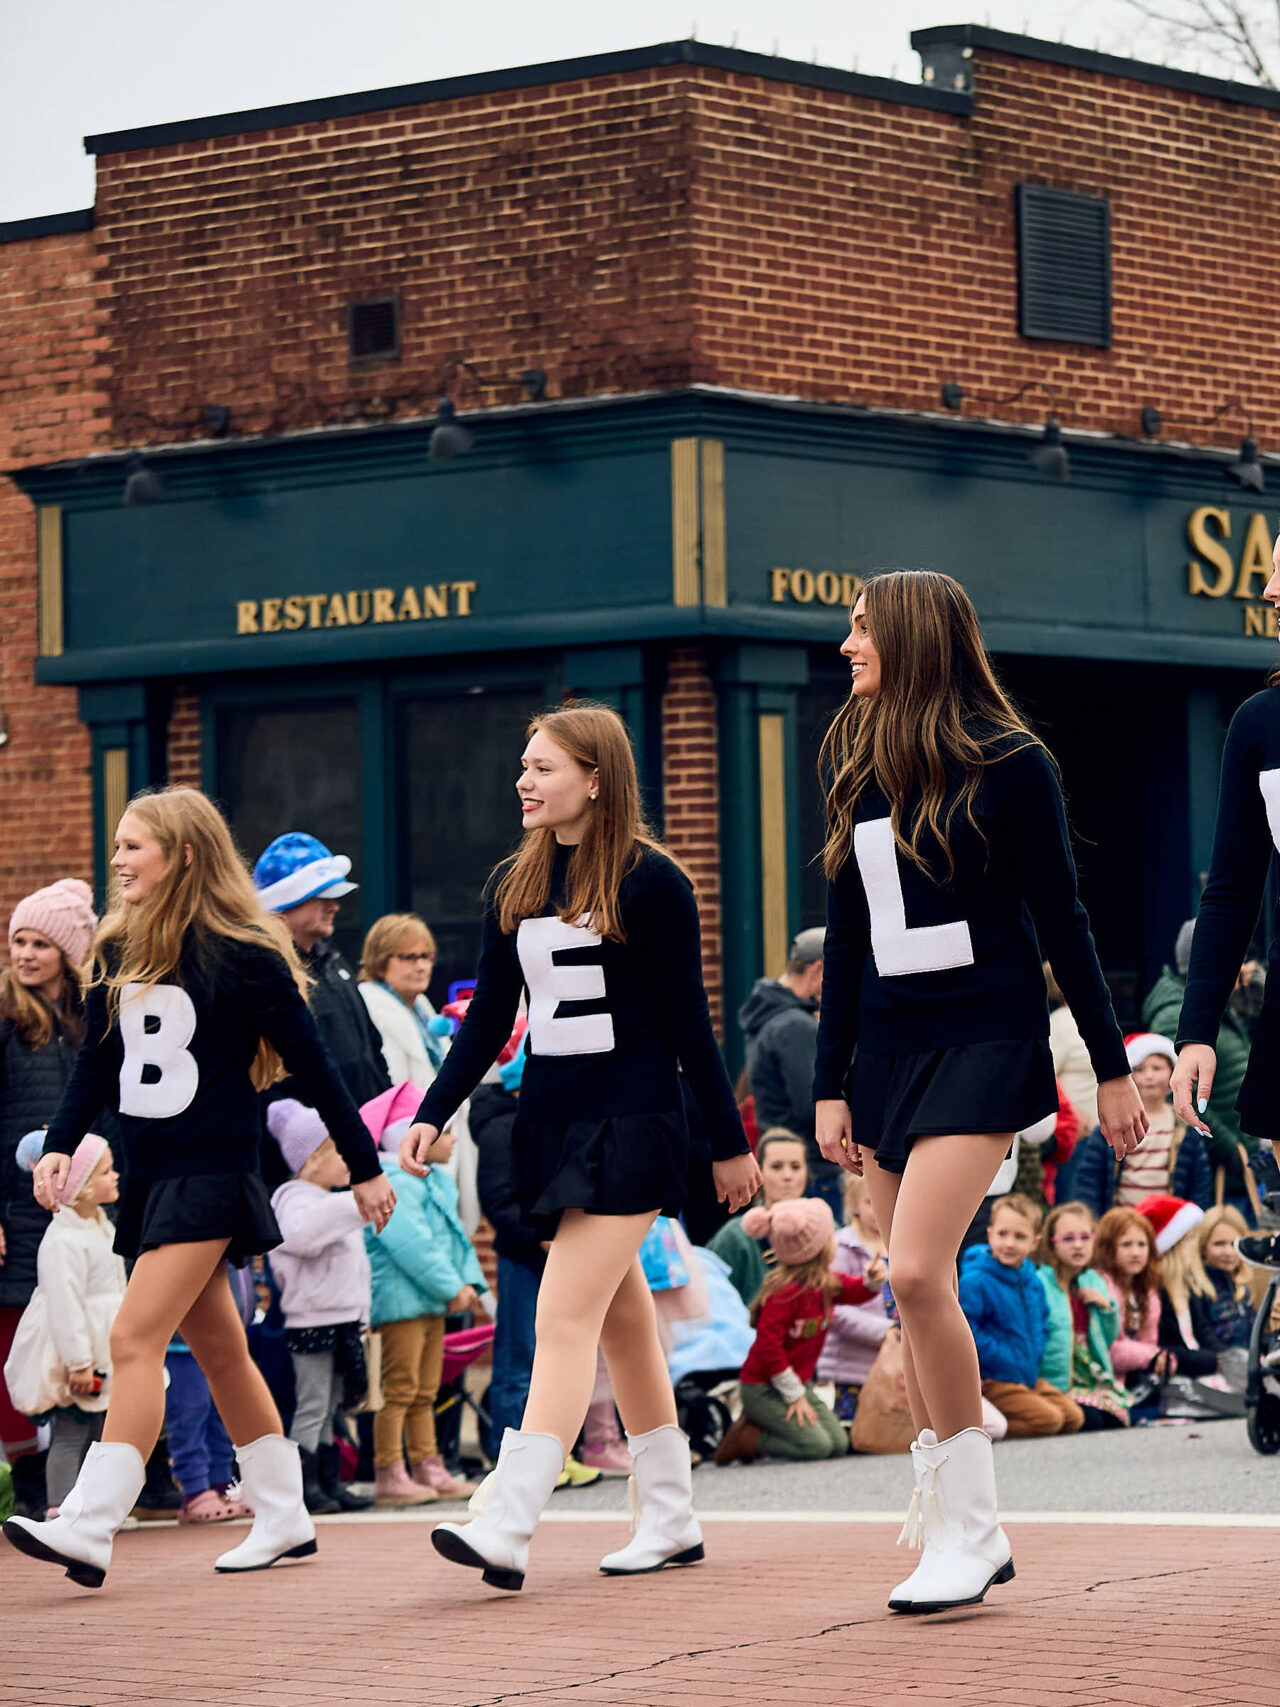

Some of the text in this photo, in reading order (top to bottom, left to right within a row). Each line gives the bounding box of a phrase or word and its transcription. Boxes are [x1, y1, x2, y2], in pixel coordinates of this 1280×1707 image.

[236, 580, 477, 635] RESTAURANT
[854, 816, 974, 976] L
[118, 982, 199, 1119] B
[516, 911, 615, 1056] E
